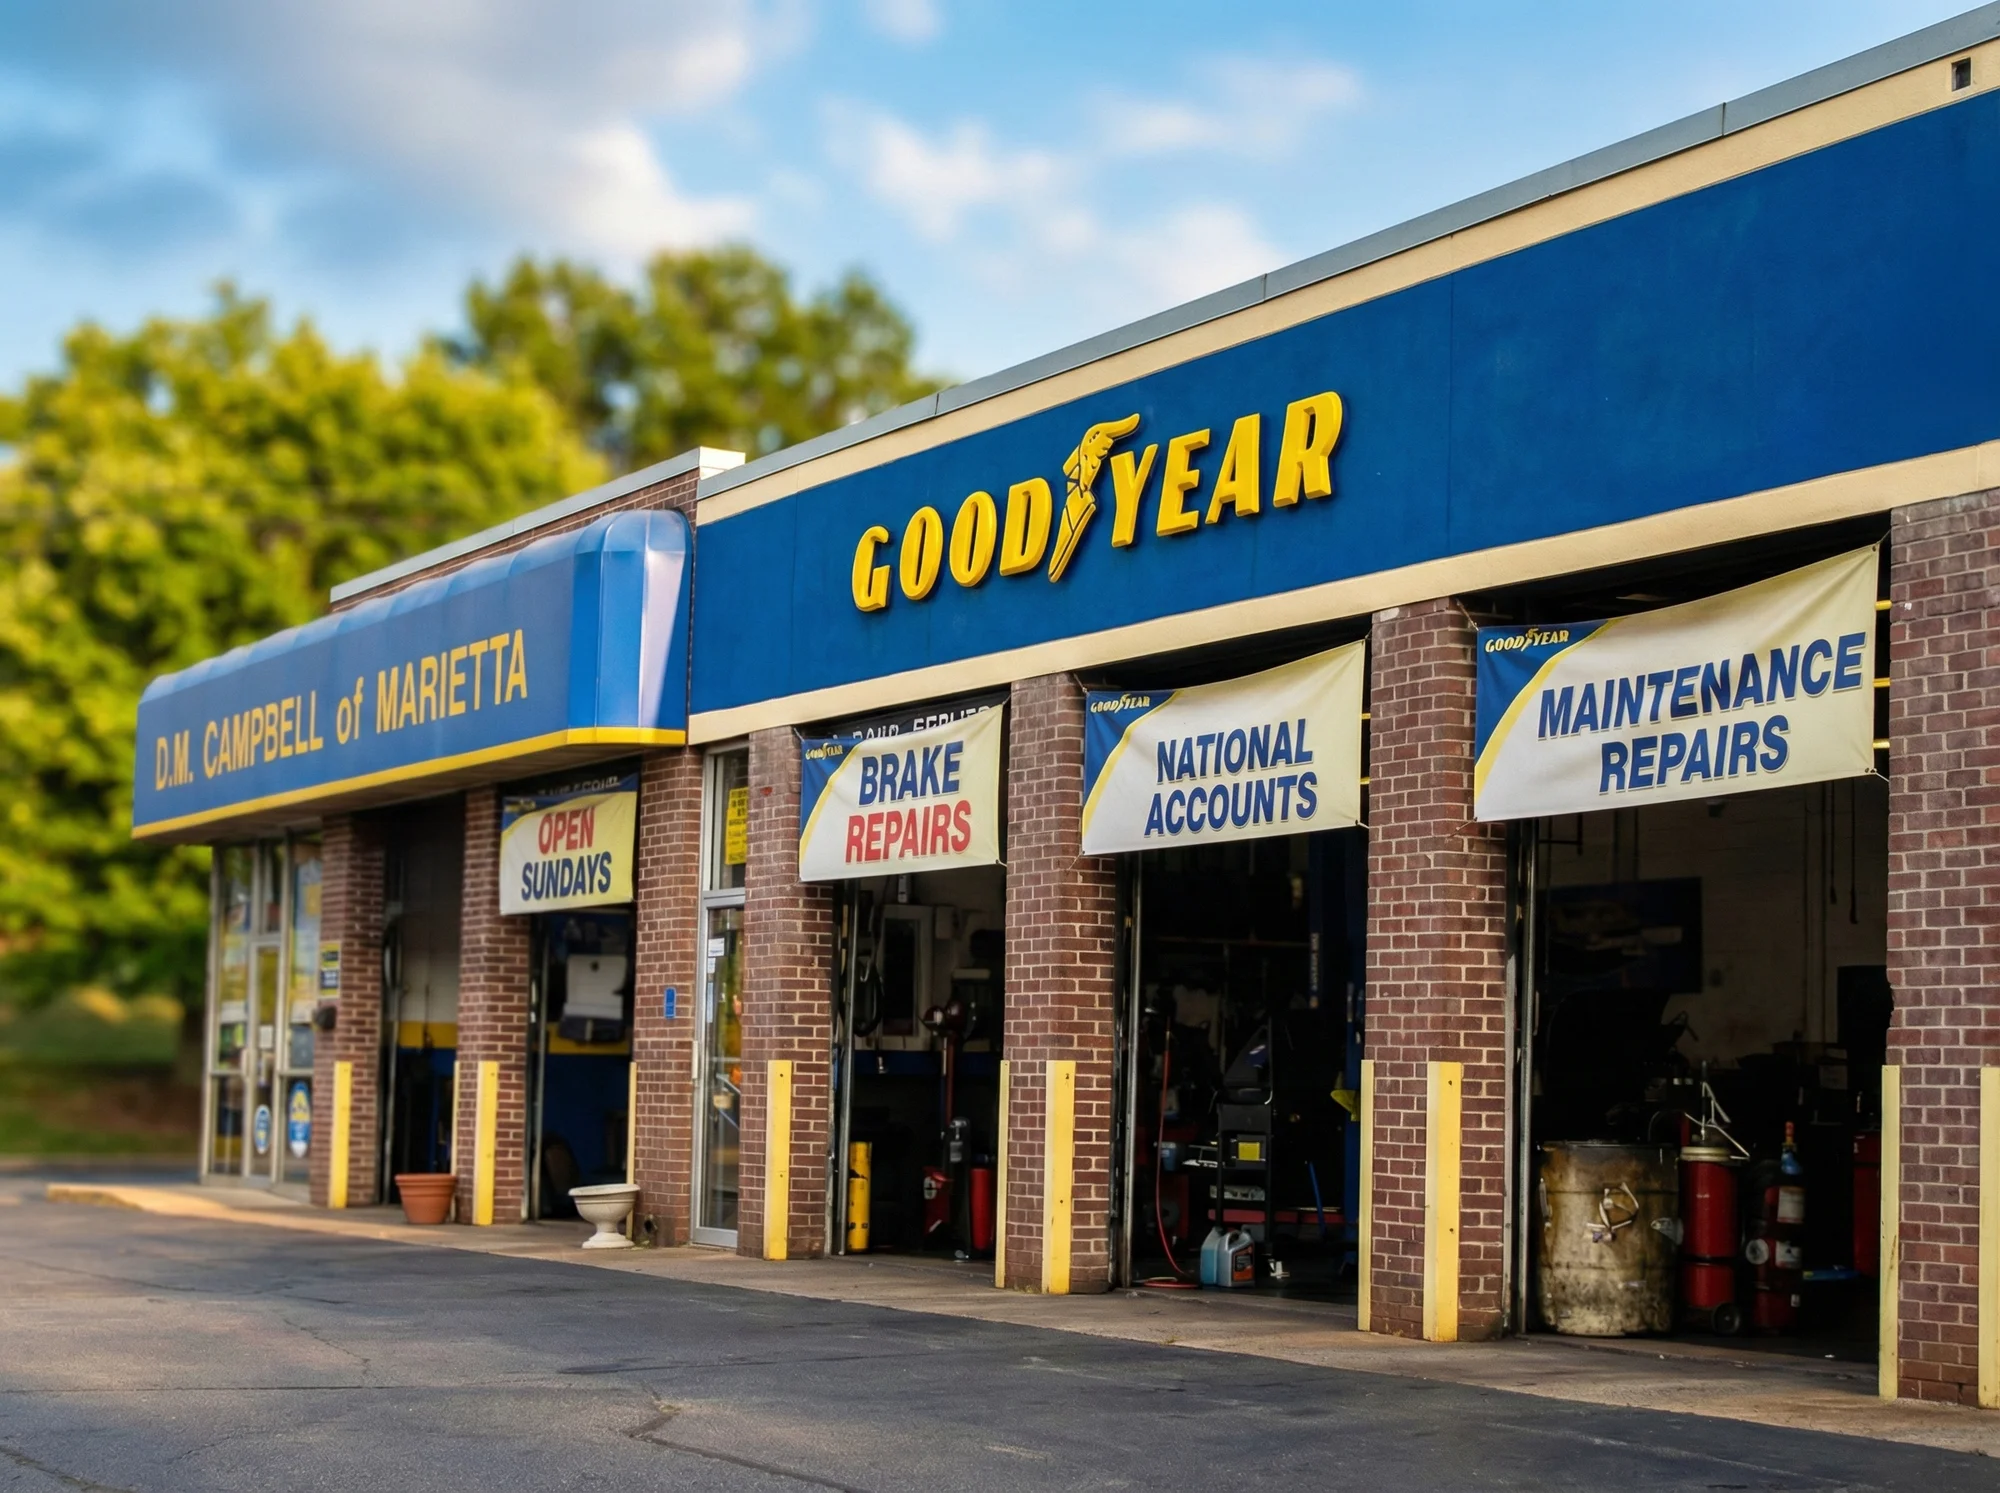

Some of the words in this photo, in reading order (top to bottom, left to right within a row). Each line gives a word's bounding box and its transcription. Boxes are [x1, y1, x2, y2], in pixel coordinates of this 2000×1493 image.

[852, 391, 1344, 612] GOODYEAR
[1485, 628, 1569, 653] GOODYEAR
[155, 729, 194, 791] D.M.
[203, 690, 323, 780] CAMPBELL
[336, 676, 364, 745] of
[376, 629, 528, 734] MARIETTA
[1537, 631, 1867, 740] MAINTENANCE
[858, 740, 964, 808] BRAKE
[1157, 718, 1314, 785] NATIONAL
[1599, 714, 1791, 795] REPAIRS
[538, 805, 595, 856] OPEN
[845, 799, 972, 864] REPAIRS
[1144, 771, 1318, 838] ACCOUNTS
[521, 851, 612, 902] SUNDAYS
